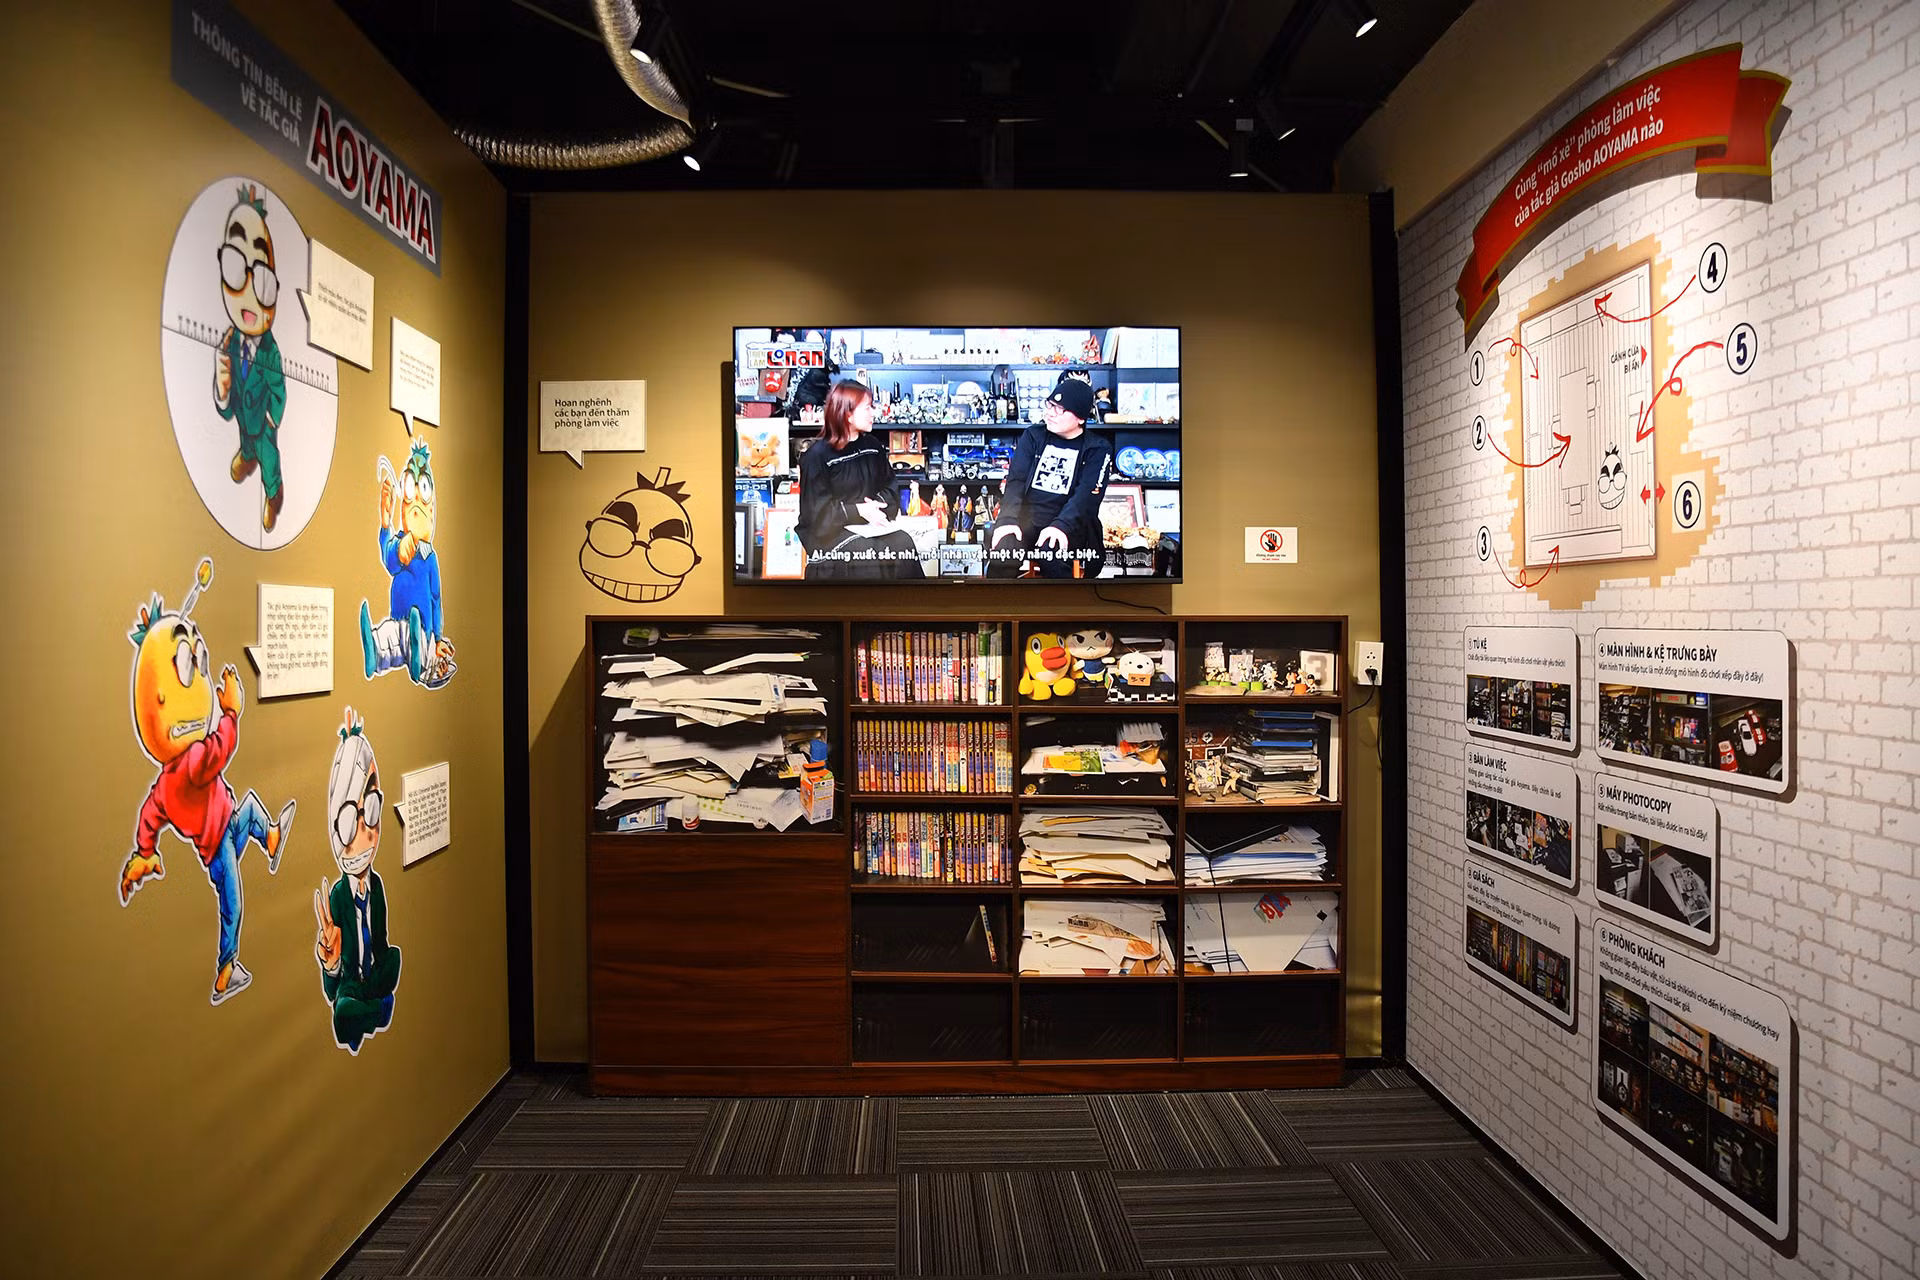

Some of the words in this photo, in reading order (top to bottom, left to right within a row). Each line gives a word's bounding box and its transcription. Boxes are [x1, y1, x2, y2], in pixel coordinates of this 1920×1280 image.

[192, 10, 240, 69] THÔNG
[242, 55, 262, 88] TIN
[265, 75, 287, 108] BÊN
[258, 98, 280, 130] TÁC
[281, 118, 300, 147] GIẢ
[1515, 172, 1537, 200] Cùng
[1578, 118, 1611, 153] phòng
[1612, 101, 1634, 126] làm
[1636, 84, 1661, 112] việc
[305, 96, 437, 265] AOYAMA
[1515, 205, 1530, 228] của
[1530, 190, 1545, 213] tác
[1545, 175, 1560, 205] giả
[1561, 158, 1592, 189] Gosho
[1593, 126, 1639, 168] AOYAMA
[1640, 114, 1664, 142] nào
[554, 399, 577, 407] Hoan
[579, 398, 612, 408] nghênh
[554, 408, 569, 417] các
[571, 408, 587, 419] bạn
[588, 408, 605, 417] đến
[607, 407, 630, 416] thăm
[554, 418, 582, 429] phòng
[584, 418, 600, 427] làm
[602, 418, 619, 429] việc
[812, 549, 823, 560] Ai
[826, 549, 850, 562] cũng
[853, 547, 876, 560] xuất
[878, 546, 896, 560] sắc
[971, 548, 987, 562] vật
[990, 549, 1010, 562] một
[1027, 549, 1053, 562] năng
[1056, 548, 1073, 562] đặc
[1076, 548, 1100, 562] biệt.
[1607, 641, 1623, 657] MÀN
[1625, 642, 1645, 658] HÌNH
[1646, 646, 1652, 658] &
[1654, 643, 1665, 663] KỆ
[1666, 645, 1698, 662] TRƯNG
[1700, 644, 1717, 662] BÀY
[1618, 663, 1624, 671] TV
[1606, 785, 1621, 801] MÁY
[1623, 790, 1671, 814] PHOTOCOPY
[1609, 932, 1635, 955] PHÒNG
[1638, 945, 1665, 968] KHÁCH
[1697, 994, 1707, 1005] cho
[1767, 1026, 1780, 1041] hay
